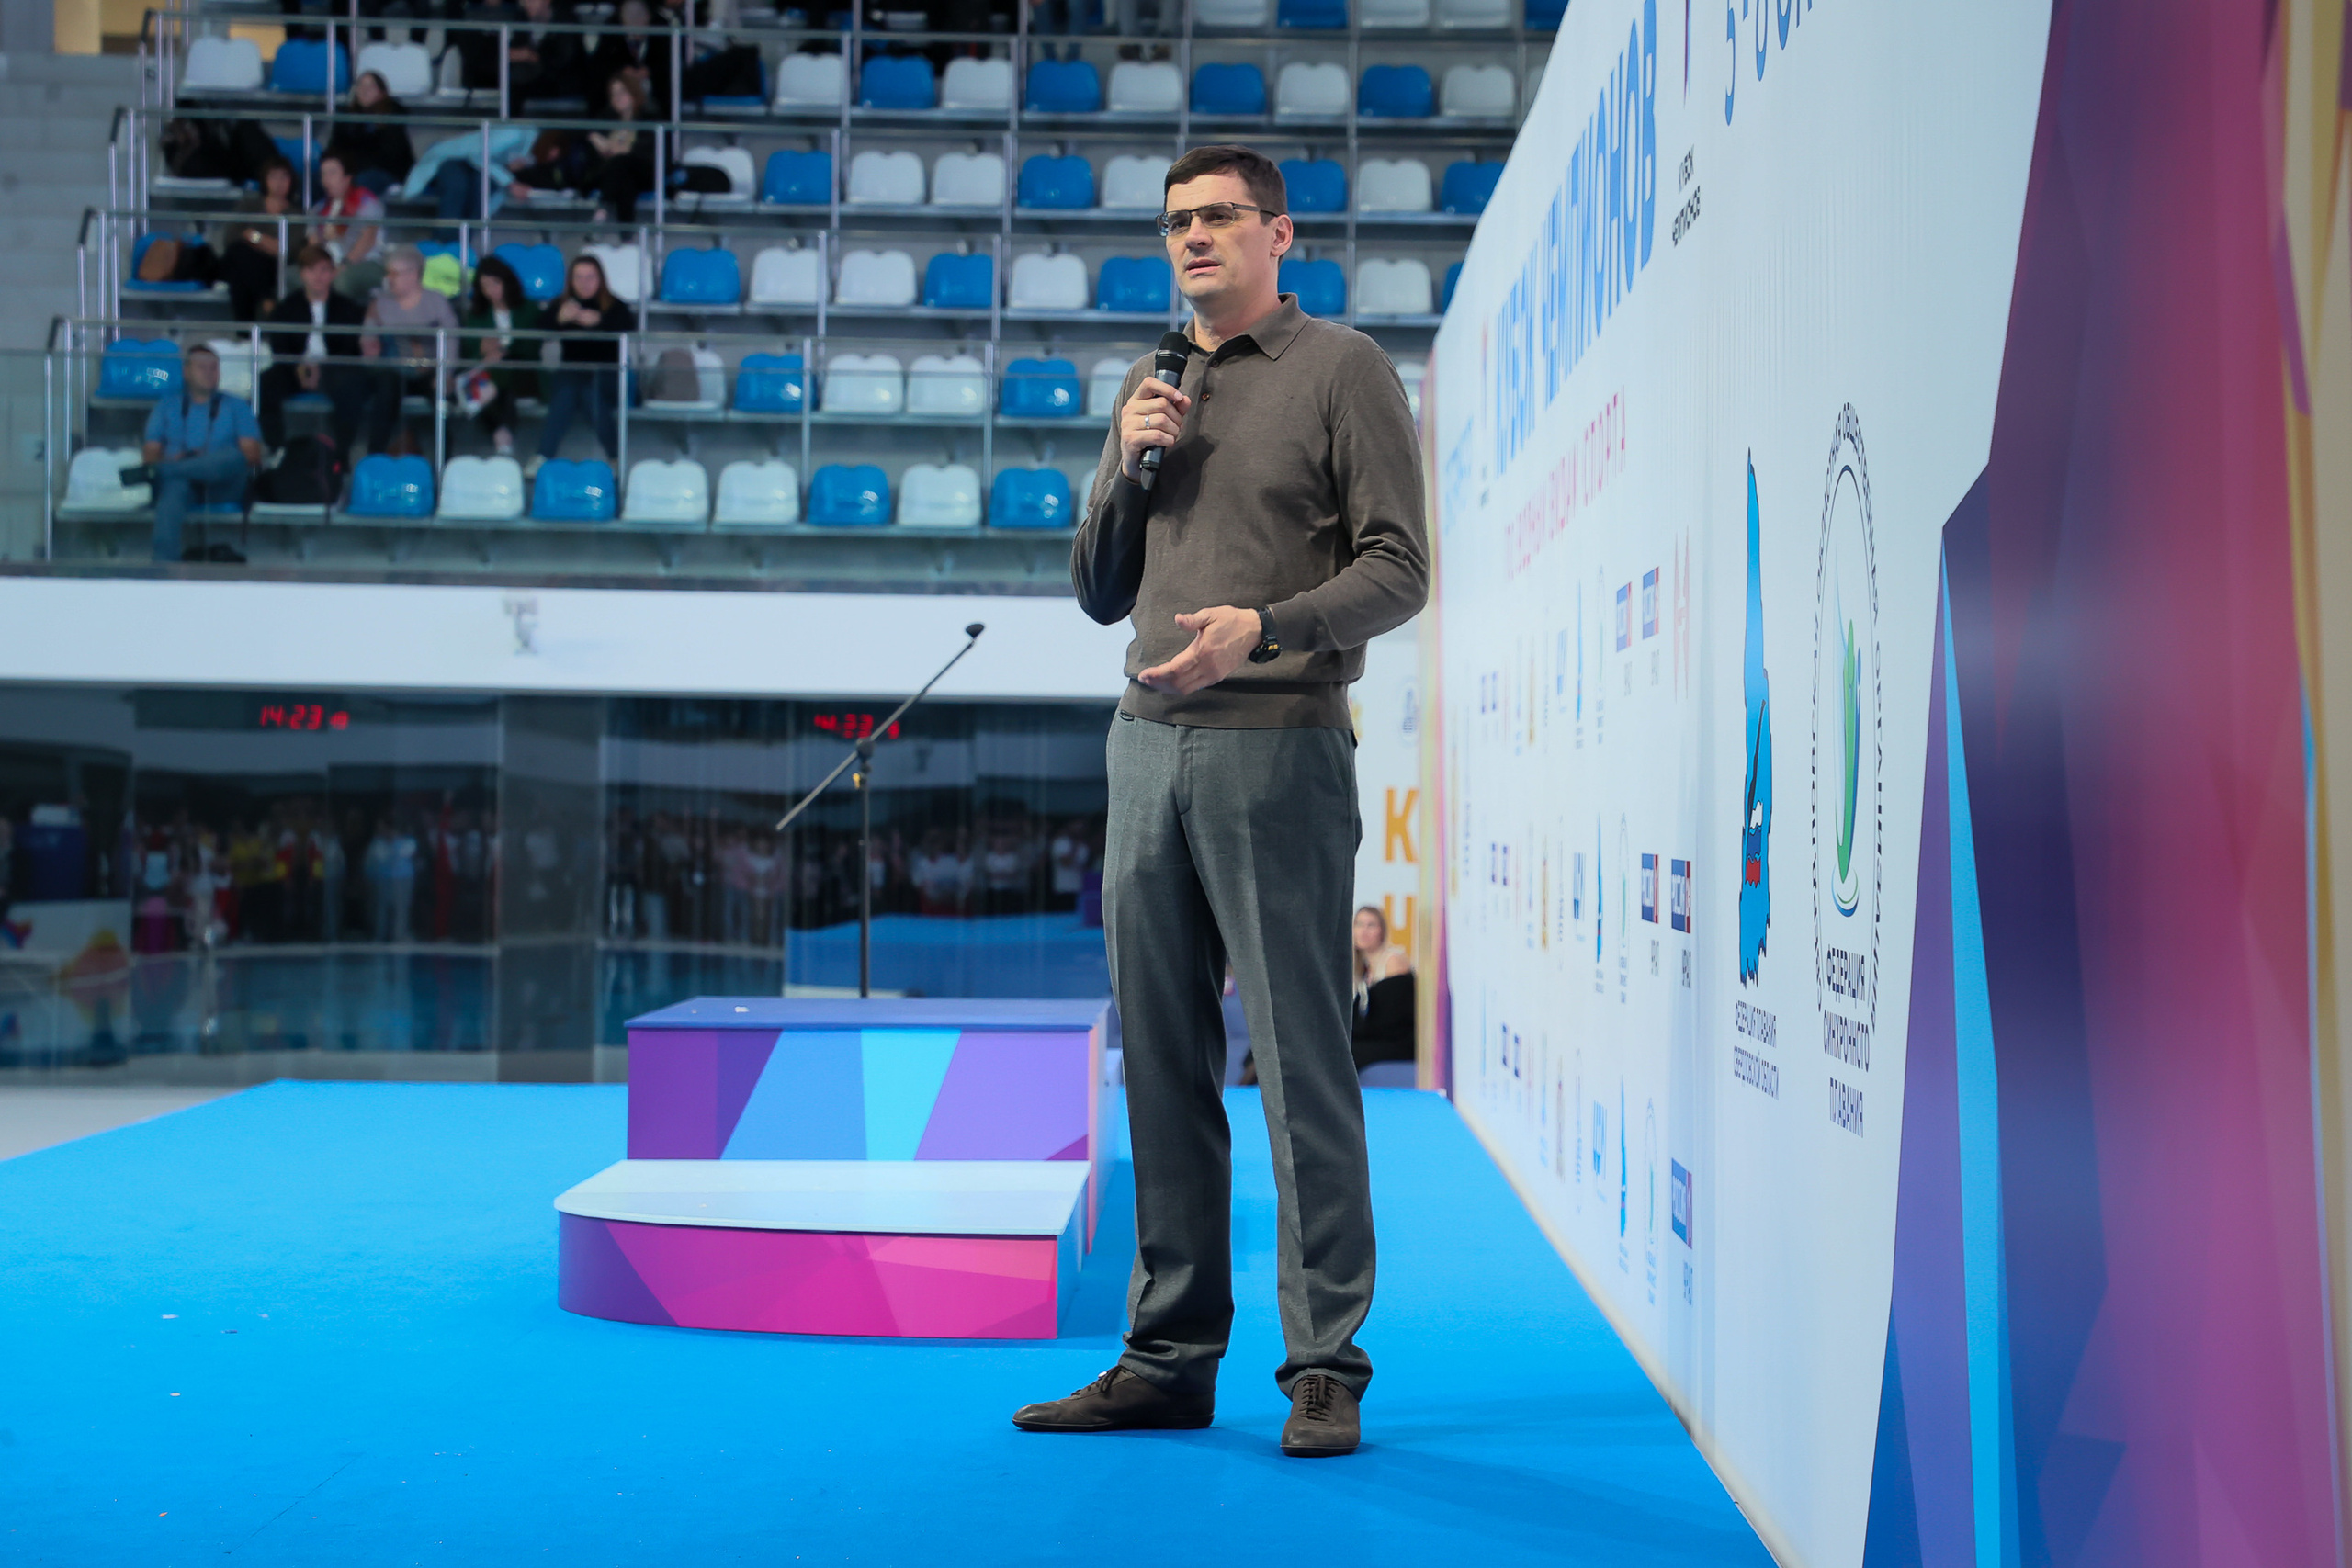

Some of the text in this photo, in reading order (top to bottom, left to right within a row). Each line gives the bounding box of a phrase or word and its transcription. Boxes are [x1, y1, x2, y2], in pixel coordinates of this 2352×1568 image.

[1495, 0, 1657, 478] КУБОК ЧЕМПИОНОВ
[1549, 440, 1579, 539] ВИДАМ
[1583, 385, 1626, 507] СПОРТА
[1826, 944, 1866, 1010] ФЕДЕРАЦИЯ
[1824, 1009, 1871, 1073] СИНХРОННОГО
[1829, 1077, 1864, 1139] ПЛАВАНИЯ
